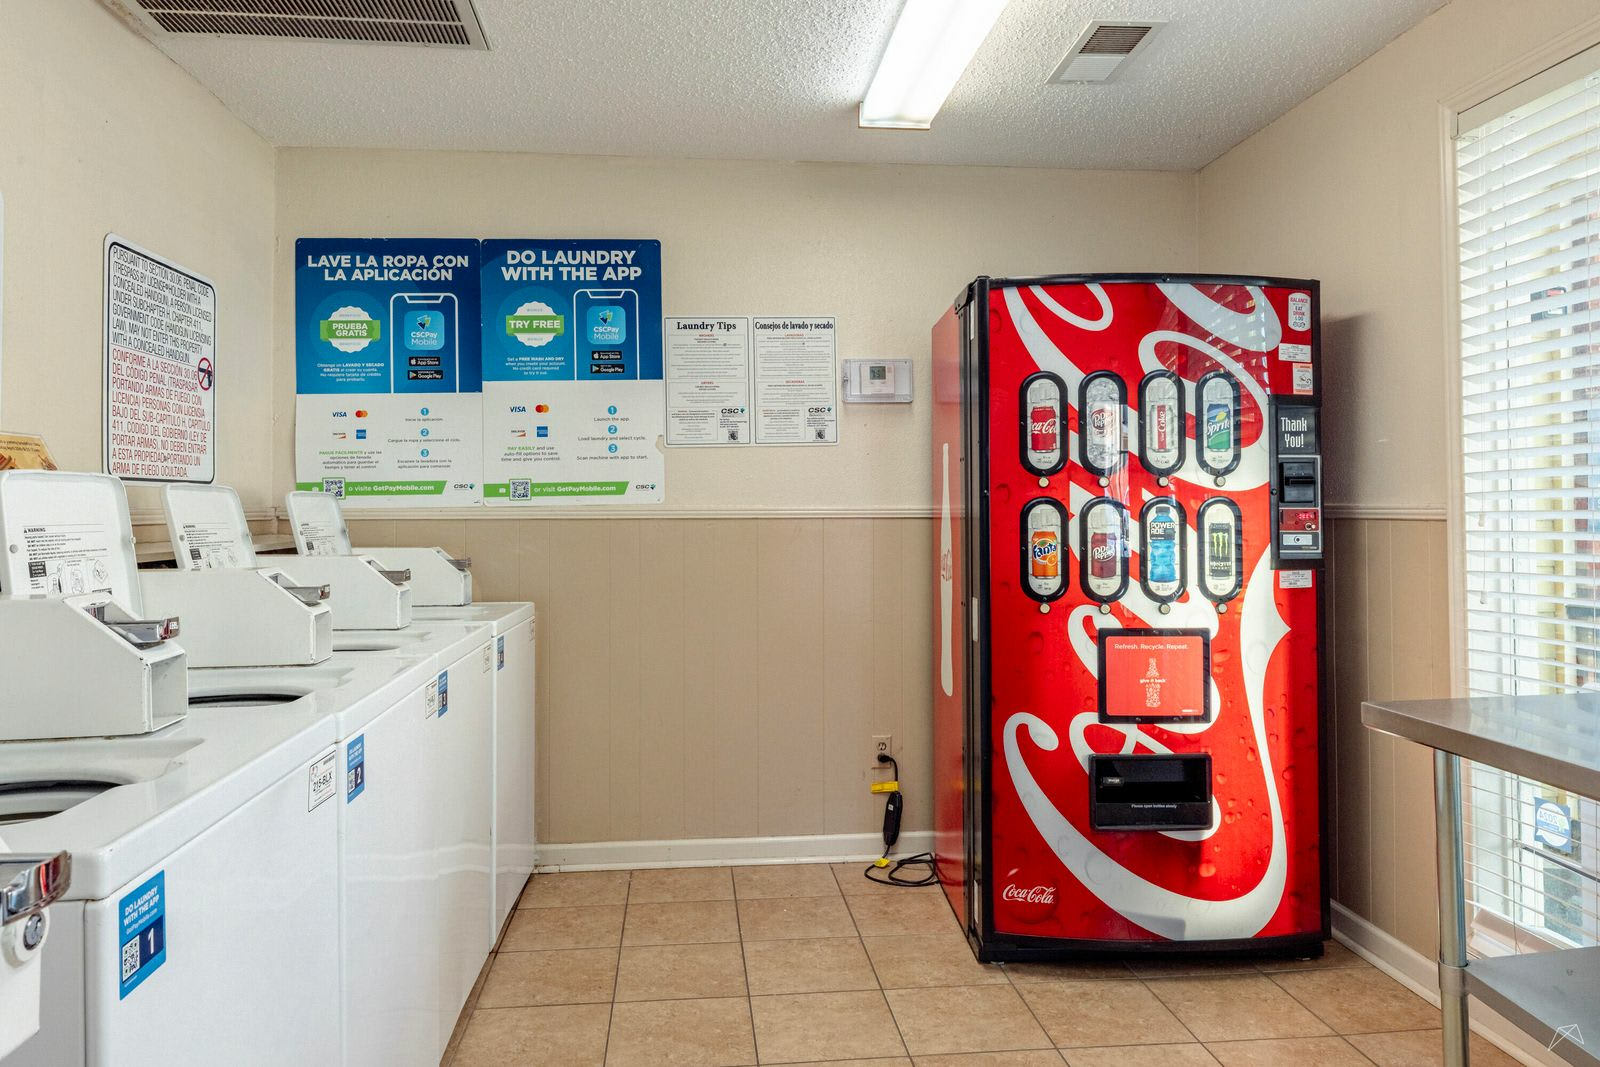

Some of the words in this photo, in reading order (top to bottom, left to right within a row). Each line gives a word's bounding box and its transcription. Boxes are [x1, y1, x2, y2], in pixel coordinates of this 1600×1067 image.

[113, 246, 140, 268] PURSUANT
[149, 262, 168, 280] SECTION
[307, 255, 351, 267] LAVE
[355, 255, 379, 267] LA
[382, 255, 428, 267] ROPA
[432, 255, 469, 267] CON
[506, 250, 536, 264] DO
[541, 250, 636, 265] LAUNDRY
[324, 269, 347, 281] LA
[351, 266, 453, 281] APLICACIÓN
[501, 266, 553, 281] WITH
[558, 266, 598, 281] THE
[602, 266, 642, 281] APP
[113, 275, 143, 297] CONCEALED
[113, 289, 131, 305] UNDER
[133, 296, 165, 318] SUBCHAPTER
[113, 303, 149, 325] GOVERNMENT
[508, 319, 531, 329] TRY
[533, 319, 561, 329] FREE
[677, 322, 715, 332] Laundry
[717, 322, 737, 332] Tips
[755, 321, 781, 331] Consejos
[781, 321, 789, 330] de
[790, 321, 809, 330] lavado
[810, 323, 814, 331] y
[814, 321, 834, 330] secado
[153, 330, 168, 344] ENTER
[335, 329, 368, 337] GRATIS
[411, 331, 438, 339] CSCPay
[593, 332, 620, 340] Mobile
[133, 337, 164, 356] CONCEALED
[411, 338, 438, 346] Mobile
[113, 348, 146, 367] CONFORME
[152, 358, 160, 371] LA
[112, 362, 124, 376] DEL
[150, 371, 166, 386] PENAL
[112, 376, 144, 394] PORTANDO
[145, 384, 164, 399] ARMAS
[166, 388, 173, 400] DE
[142, 396, 170, 412] PERSONAS
[112, 404, 128, 419] BAJO
[130, 407, 141, 421] DEL
[1158, 410, 1167, 432] Coke
[1280, 417, 1308, 431] Thank
[150, 424, 160, 437] DEL
[112, 433, 136, 446] PORTAR
[1284, 433, 1304, 448] You!
[118, 448, 132, 461] ESTA
[134, 450, 164, 463] PROPIEDAD
[167, 453, 192, 466] PORTANDO
[112, 462, 130, 474] ARMA
[131, 463, 139, 475] DE
[141, 464, 160, 476] FUEGO
[372, 485, 435, 493] GetPayMobile.com
[556, 485, 616, 493] GetPayMobile.com
[357, 767, 362, 785] 2
[125, 903, 134, 916] DO
[134, 885, 158, 909] LAUNDRY
[1002, 884, 1057, 904] Coca-Cola
[123, 910, 138, 927] WITH
[139, 901, 149, 914] THE
[149, 894, 160, 907] APP
[148, 928, 154, 954] 1
